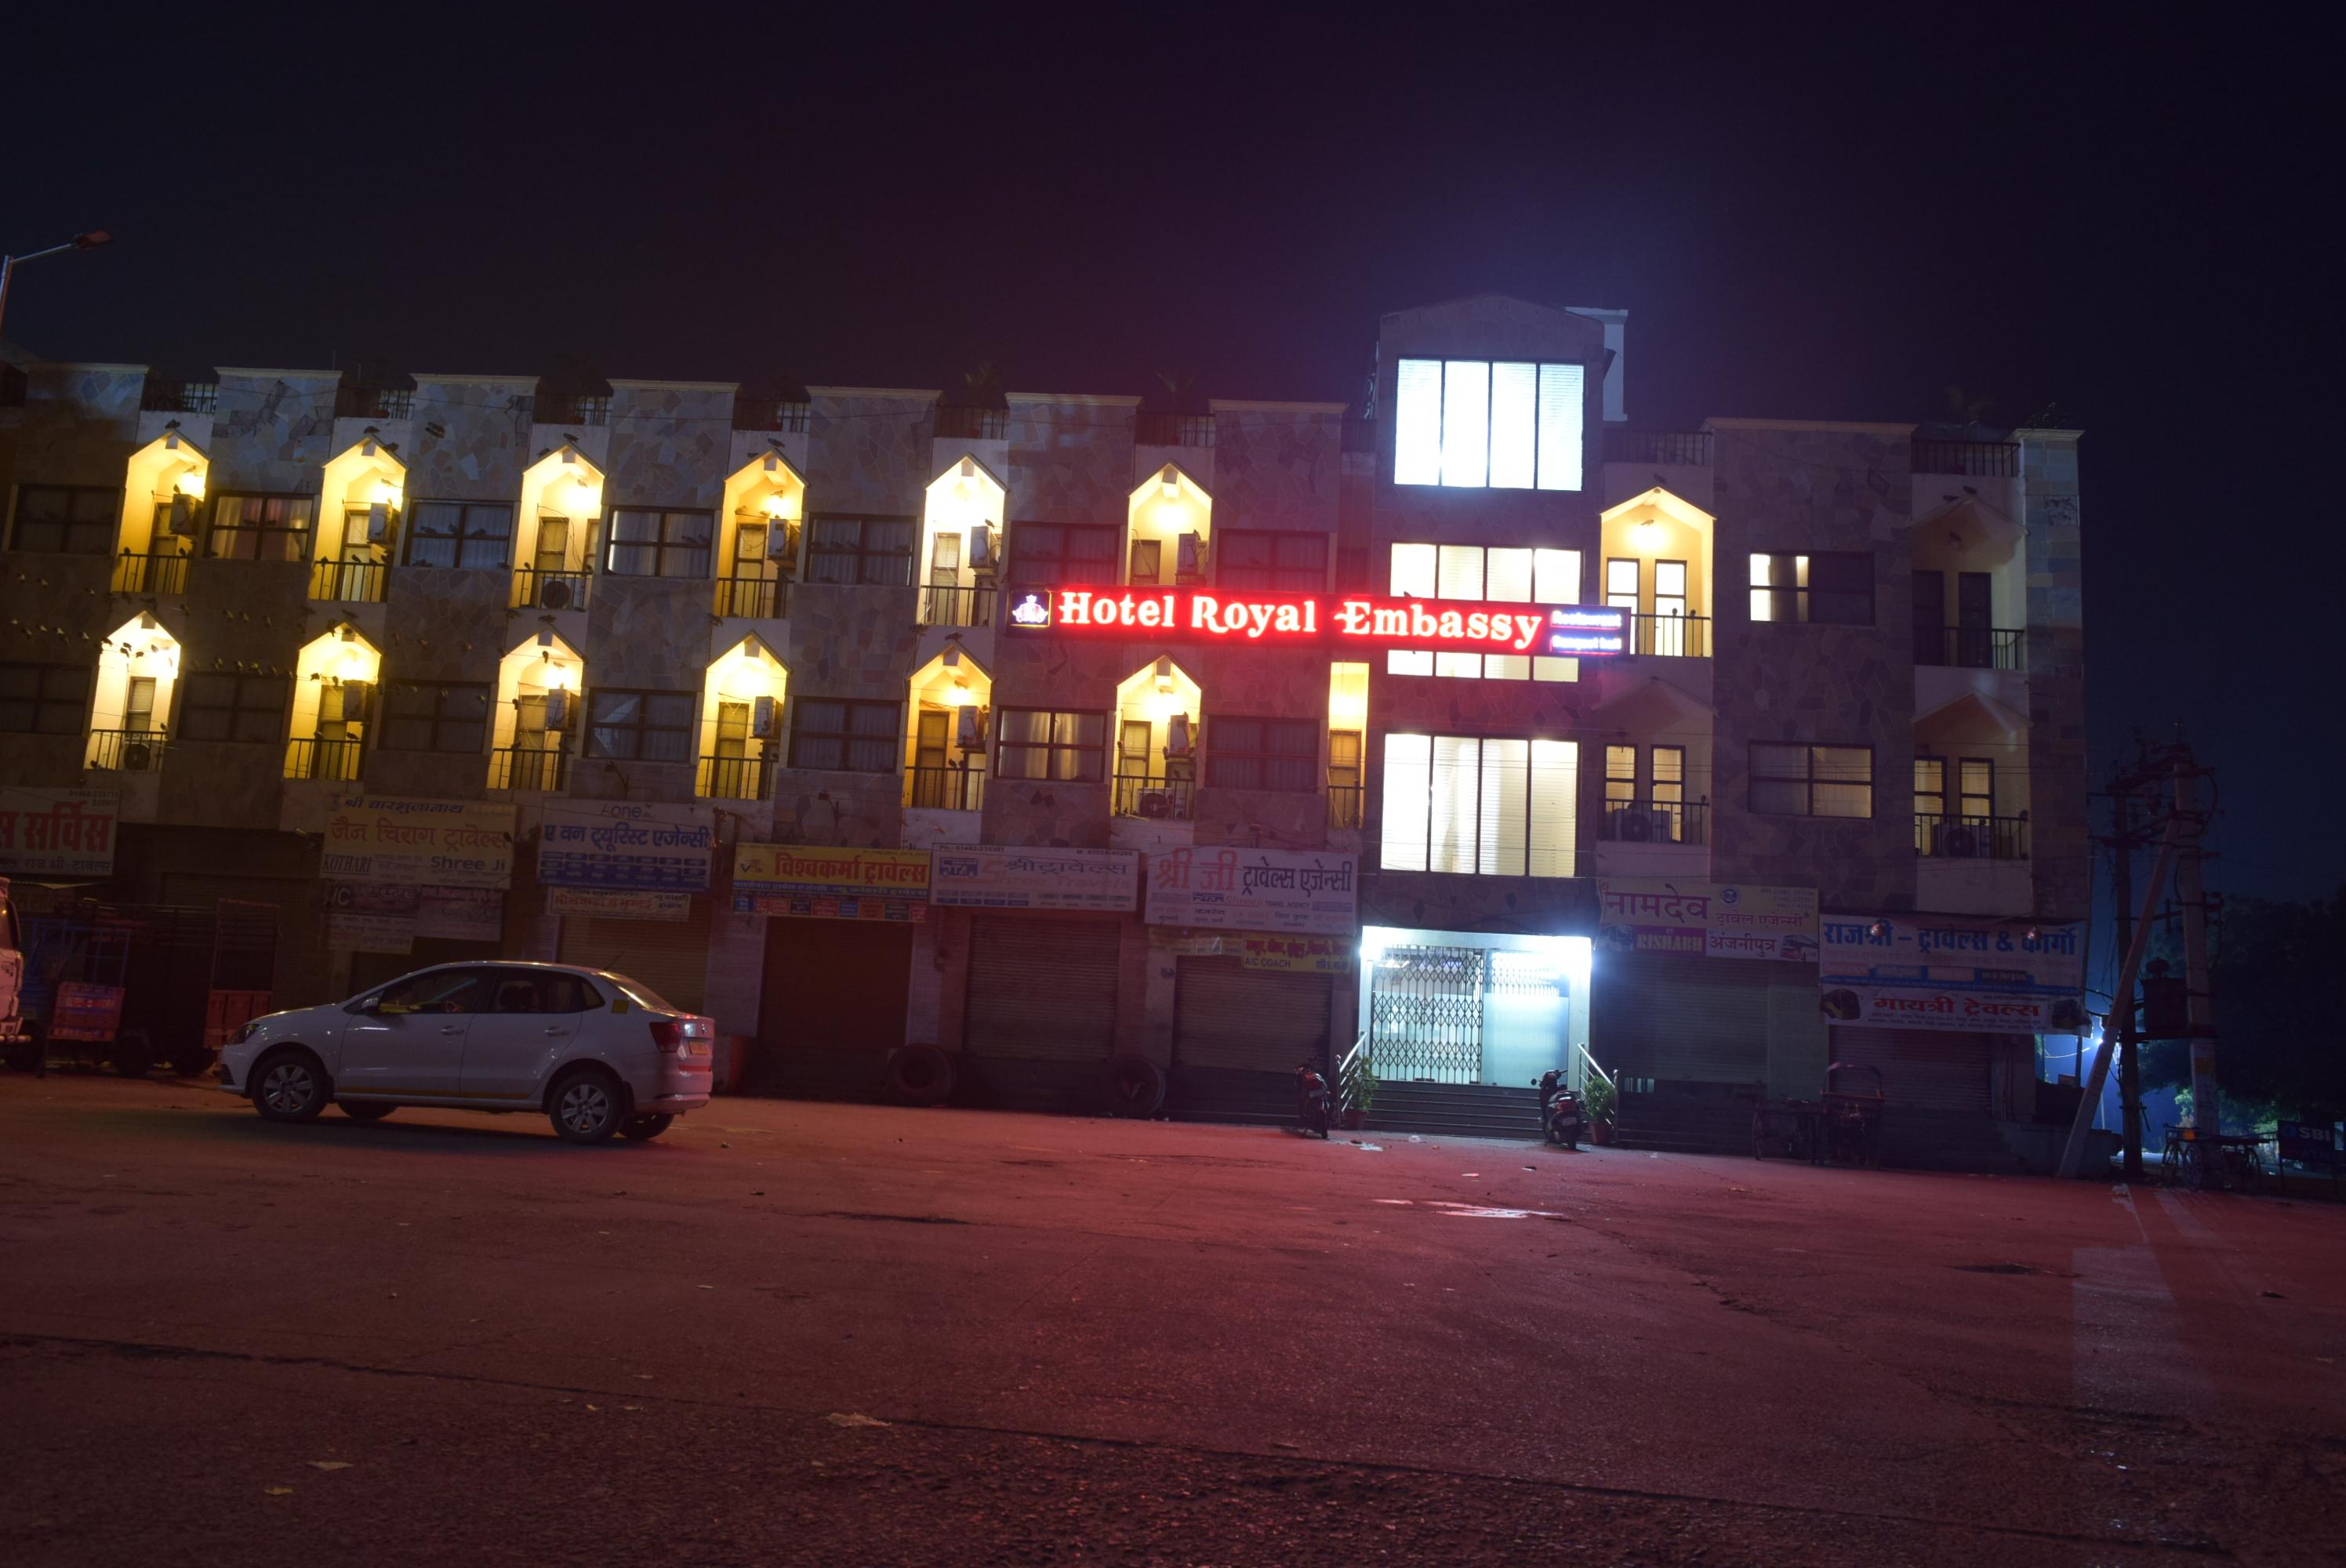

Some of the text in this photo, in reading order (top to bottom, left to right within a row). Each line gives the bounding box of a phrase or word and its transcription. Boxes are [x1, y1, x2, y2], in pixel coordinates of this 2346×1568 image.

[1059, 591, 1542, 650] Hotel Royal Embassy
[344, 797, 364, 808] श्री
[24, 800, 114, 852] सर्विस
[331, 816, 510, 852] जैन चिराग ट्रावेल्स
[545, 825, 555, 841] ए
[561, 826, 587, 842] वन
[652, 824, 710, 849] एजेन्सी
[324, 855, 372, 873] KOTHARI
[430, 856, 485, 870] Shree
[492, 859, 506, 872] Ji
[775, 852, 862, 879] विश्वकर्मा
[863, 857, 928, 885] ट्रावेल्स
[1154, 848, 1353, 898] श्री जी ट्रावेल्स एजेन्सी
[1604, 883, 1712, 924] नामदेव
[1757, 910, 1810, 929] एजेन्सी
[1637, 934, 1703, 953] RISHABH
[1709, 931, 1778, 957] अंजनीपुत्र
[1917, 924, 1990, 953] ट्रावेल्स
[1996, 930, 2014, 952] &
[1245, 956, 1291, 967] A/C COACH
[1873, 996, 1956, 1014] गायत्री
[1963, 998, 2041, 1018] ट्रेवल्स
[2298, 1127, 2331, 1142] SBI
